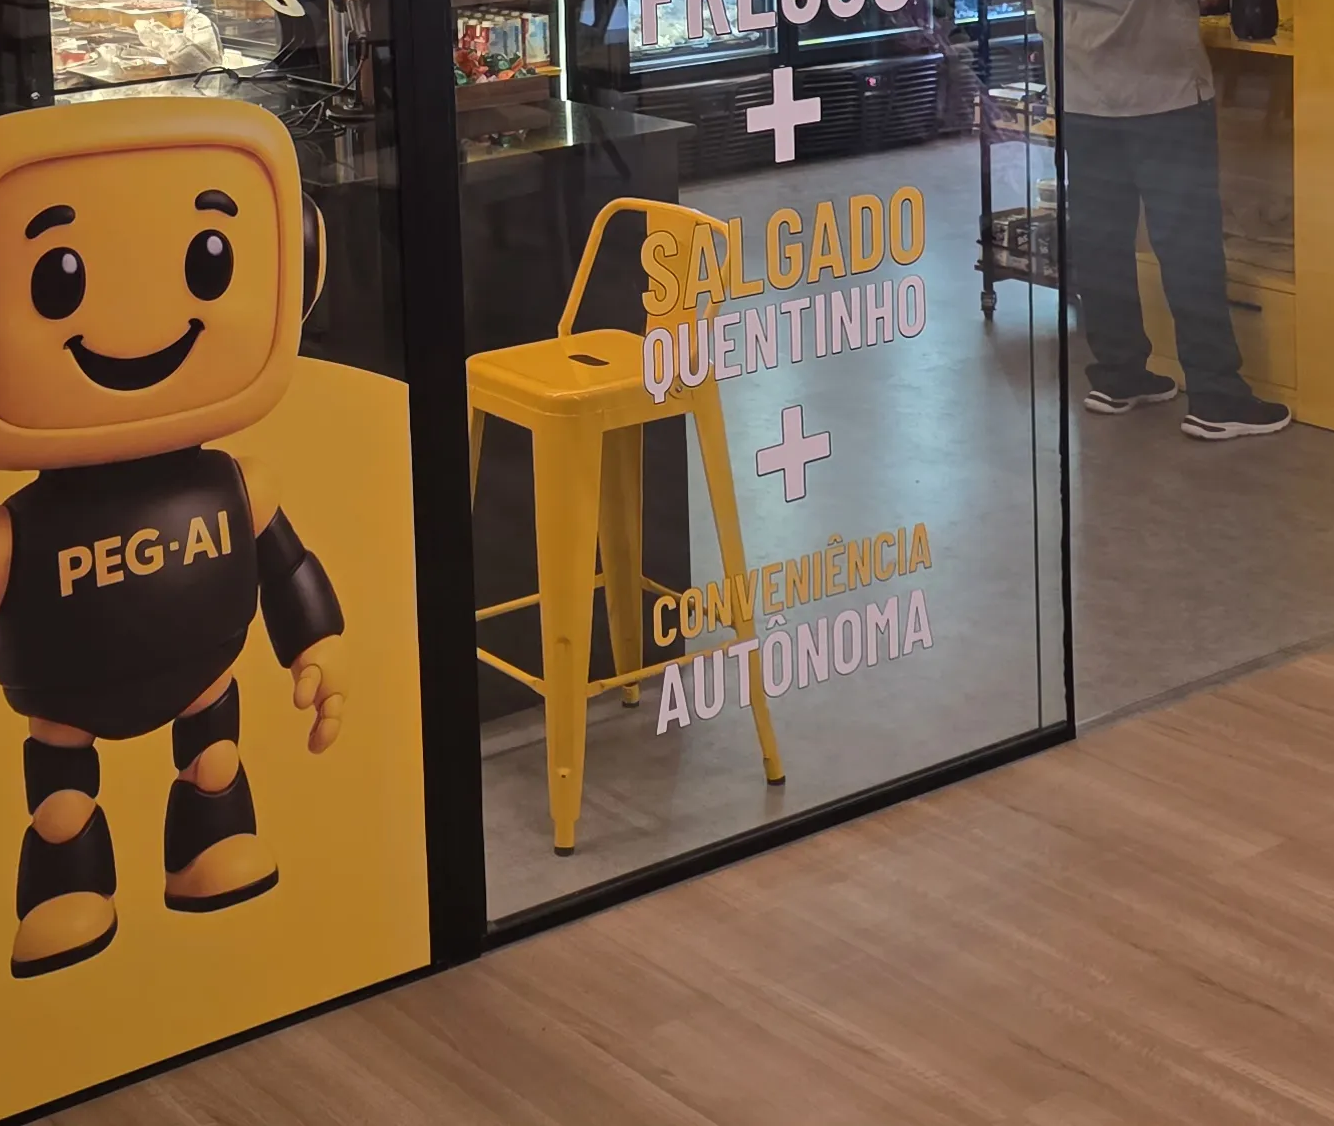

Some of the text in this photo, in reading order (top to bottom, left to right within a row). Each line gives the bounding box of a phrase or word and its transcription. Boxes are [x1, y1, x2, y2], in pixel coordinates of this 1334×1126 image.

[641, 186, 925, 317] SALGADO
[642, 275, 926, 404] QUENTINHO
[653, 523, 933, 647] CONVENIÊNCIA
[657, 589, 934, 736] AUTÔNOMA
